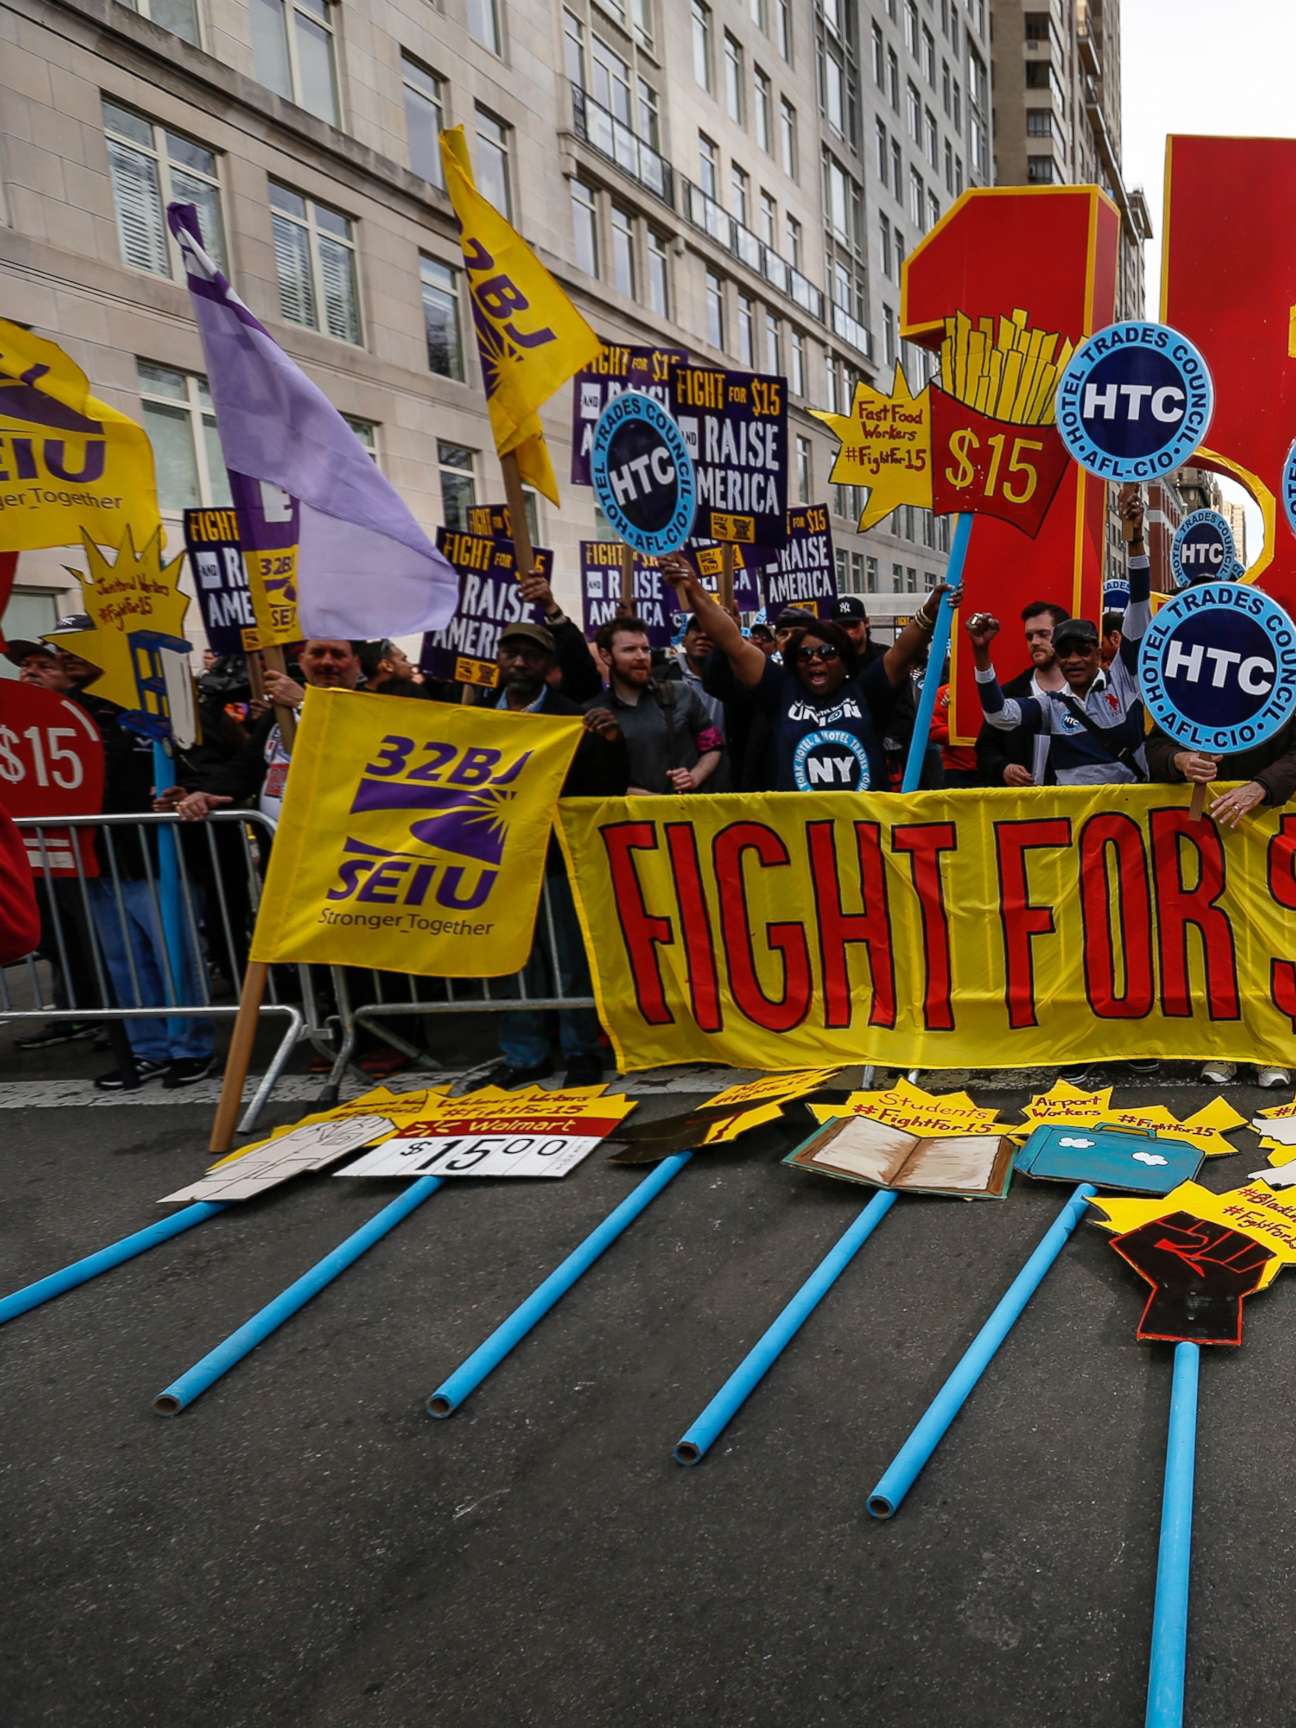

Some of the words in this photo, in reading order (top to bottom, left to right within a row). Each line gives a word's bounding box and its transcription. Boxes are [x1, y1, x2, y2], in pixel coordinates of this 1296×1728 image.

[1081, 327, 1169, 363] TRADES
[676, 368, 725, 409] FIGHT
[728, 387, 747, 404] FOR
[751, 378, 780, 416] $15
[1062, 370, 1086, 444] HOTEL
[1083, 383, 1185, 423] HTC
[1173, 345, 1207, 443] COUNCIL
[595, 399, 641, 452] TRADES
[858, 401, 890, 422] Fast
[891, 404, 923, 425] Food
[861, 422, 917, 441] Workers
[645, 404, 692, 499] COUNCIL
[704, 415, 780, 471] RAISE
[845, 447, 927, 475] #FightFor15
[608, 446, 676, 506] HTC
[945, 427, 1043, 504] $15
[1083, 450, 1173, 477] AFL-CIO
[594, 462, 629, 535] HOTEL
[697, 466, 780, 516] MERICA
[189, 511, 240, 541] FIGHT
[634, 513, 689, 551] AFL-CIO
[807, 509, 826, 534] $15
[443, 532, 495, 572] FIGHT
[494, 552, 513, 568] FOR
[586, 544, 624, 566] FIGHT
[1172, 536, 1183, 578] HOTEL
[1180, 512, 1217, 534] TRADES
[1217, 520, 1233, 575] COUNCIL
[1181, 543, 1224, 564] HTC
[769, 570, 833, 603] AMERICA
[1167, 588, 1265, 619] TRADES
[1143, 623, 1171, 704] HOTEL
[1164, 640, 1275, 696] HTC
[1263, 614, 1296, 721] COUNCIL
[1064, 716, 1079, 726] HTC
[1160, 711, 1256, 748] AFL-CIO
[0, 724, 83, 789] $15
[365, 735, 534, 786] 32BJ
[808, 756, 855, 783] NY
[327, 860, 498, 911] SEIU
[404, 914, 494, 936] Together
[601, 818, 957, 1034] FIGHT
[996, 806, 1242, 1032] FOR
[878, 1093, 988, 1120] Students
[1033, 1096, 1101, 1108] Airport
[1033, 1107, 1101, 1117] Workers
[469, 1120, 576, 1132] Walmart
